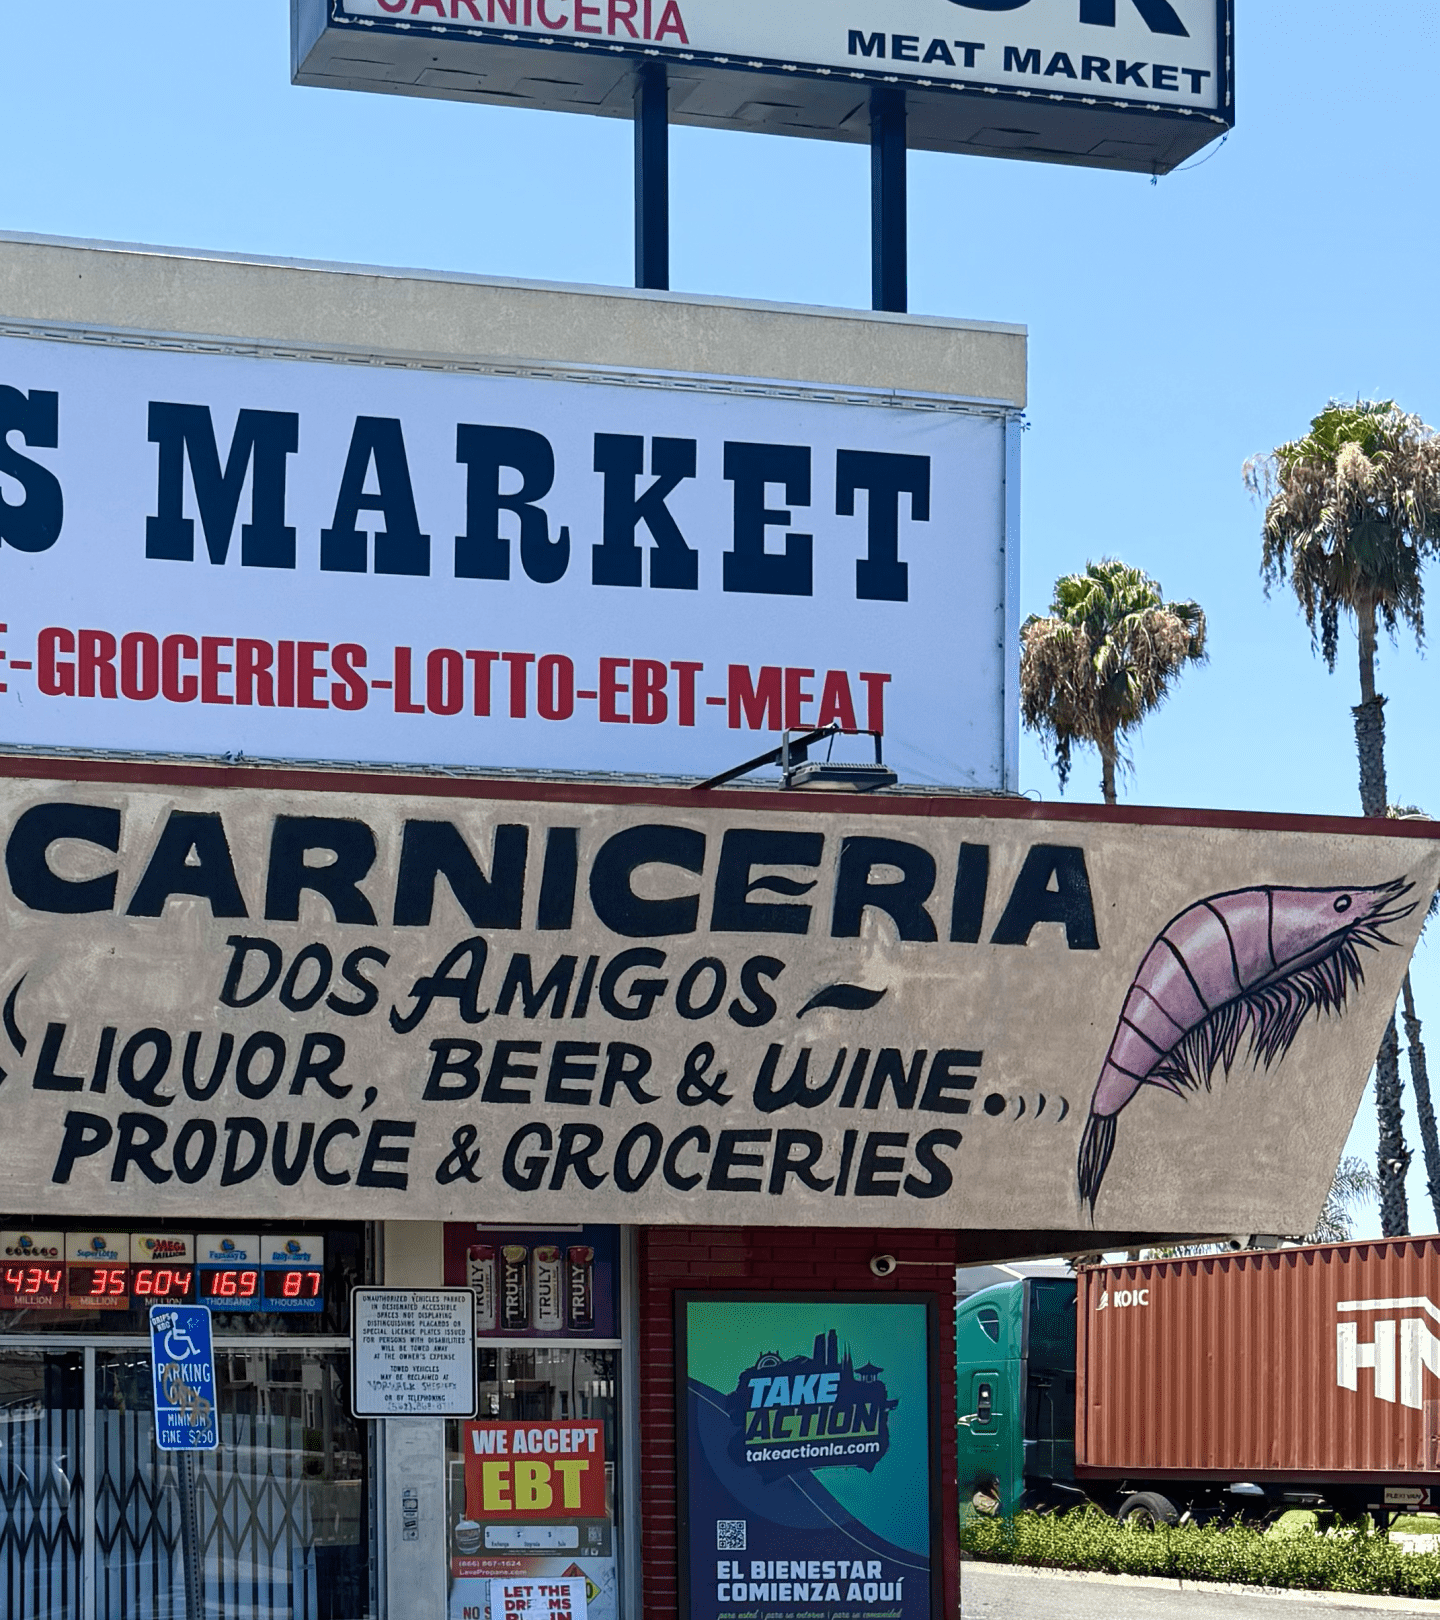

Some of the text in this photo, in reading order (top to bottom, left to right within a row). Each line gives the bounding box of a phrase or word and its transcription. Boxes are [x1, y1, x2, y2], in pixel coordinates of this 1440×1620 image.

[847, 29, 1211, 94] MEAT MARKET
[145, 400, 931, 602] MARKET
[5, 802, 1100, 950] CARNICERIA
[219, 934, 787, 1034] DOS AMIGOS
[33, 1022, 378, 1112] LIQUOR,
[422, 1038, 660, 1106] BEER
[676, 1041, 733, 1107] &
[52, 1111, 963, 1200] PRODUCE & GROCERIES
[5, 1268, 62, 1294] 434
[90, 1269, 125, 1295] 35
[134, 1269, 192, 1295] 604
[211, 1271, 258, 1297] 169
[282, 1272, 321, 1297] 87
[506, 1264, 519, 1319] TRULY
[539, 1265, 552, 1319] TRULY
[572, 1265, 585, 1319] TRULY
[14, 1295, 52, 1305] MILLION
[80, 1296, 118, 1306] MILLION
[145, 1297, 182, 1306] MILLION
[206, 1297, 252, 1306] THOUSAND
[270, 1298, 315, 1307] THOUSAND
[363, 1295, 466, 1303] UNAUTHORIZED VEHICLES PARKED
[1113, 1289, 1149, 1307] KOIC
[157, 1363, 211, 1383] PARKING
[748, 1372, 841, 1408] TAKE
[162, 1429, 214, 1444] FINE $250
[745, 1403, 879, 1444] ACTION
[472, 1428, 598, 1455] WE ACCEPT
[745, 1441, 880, 1462] takeactionla.com
[482, 1459, 589, 1511] EBT
[717, 1560, 882, 1579] EL BIENESTAR
[503, 1584, 571, 1598] LET THE
[717, 1577, 905, 1603] COMIENZA AQUÍ
[504, 1598, 572, 1611] DRMS
